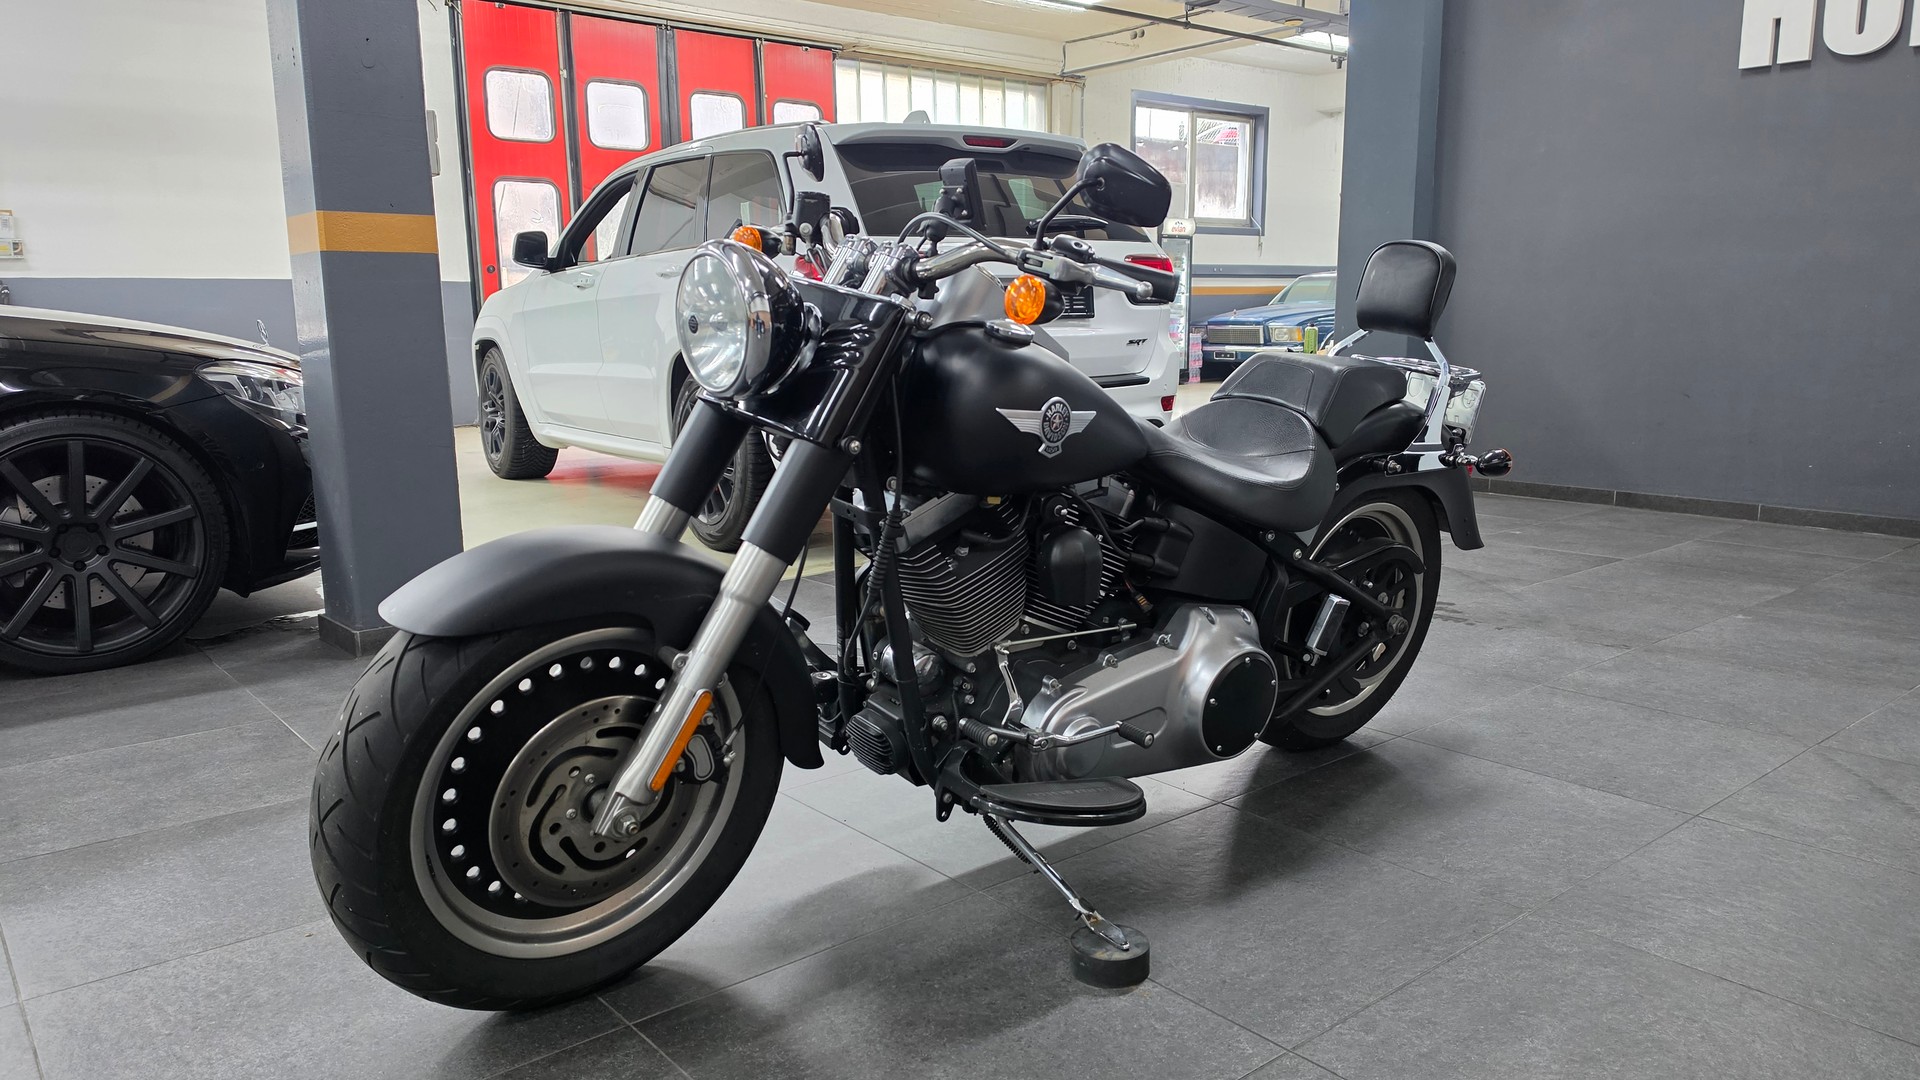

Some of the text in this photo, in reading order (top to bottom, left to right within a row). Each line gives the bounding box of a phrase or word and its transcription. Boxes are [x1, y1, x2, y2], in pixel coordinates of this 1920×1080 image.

[1126, 338, 1148, 346] SRT
[1045, 403, 1069, 418] HARLEY
[1043, 421, 1069, 441] DAVIDSON
